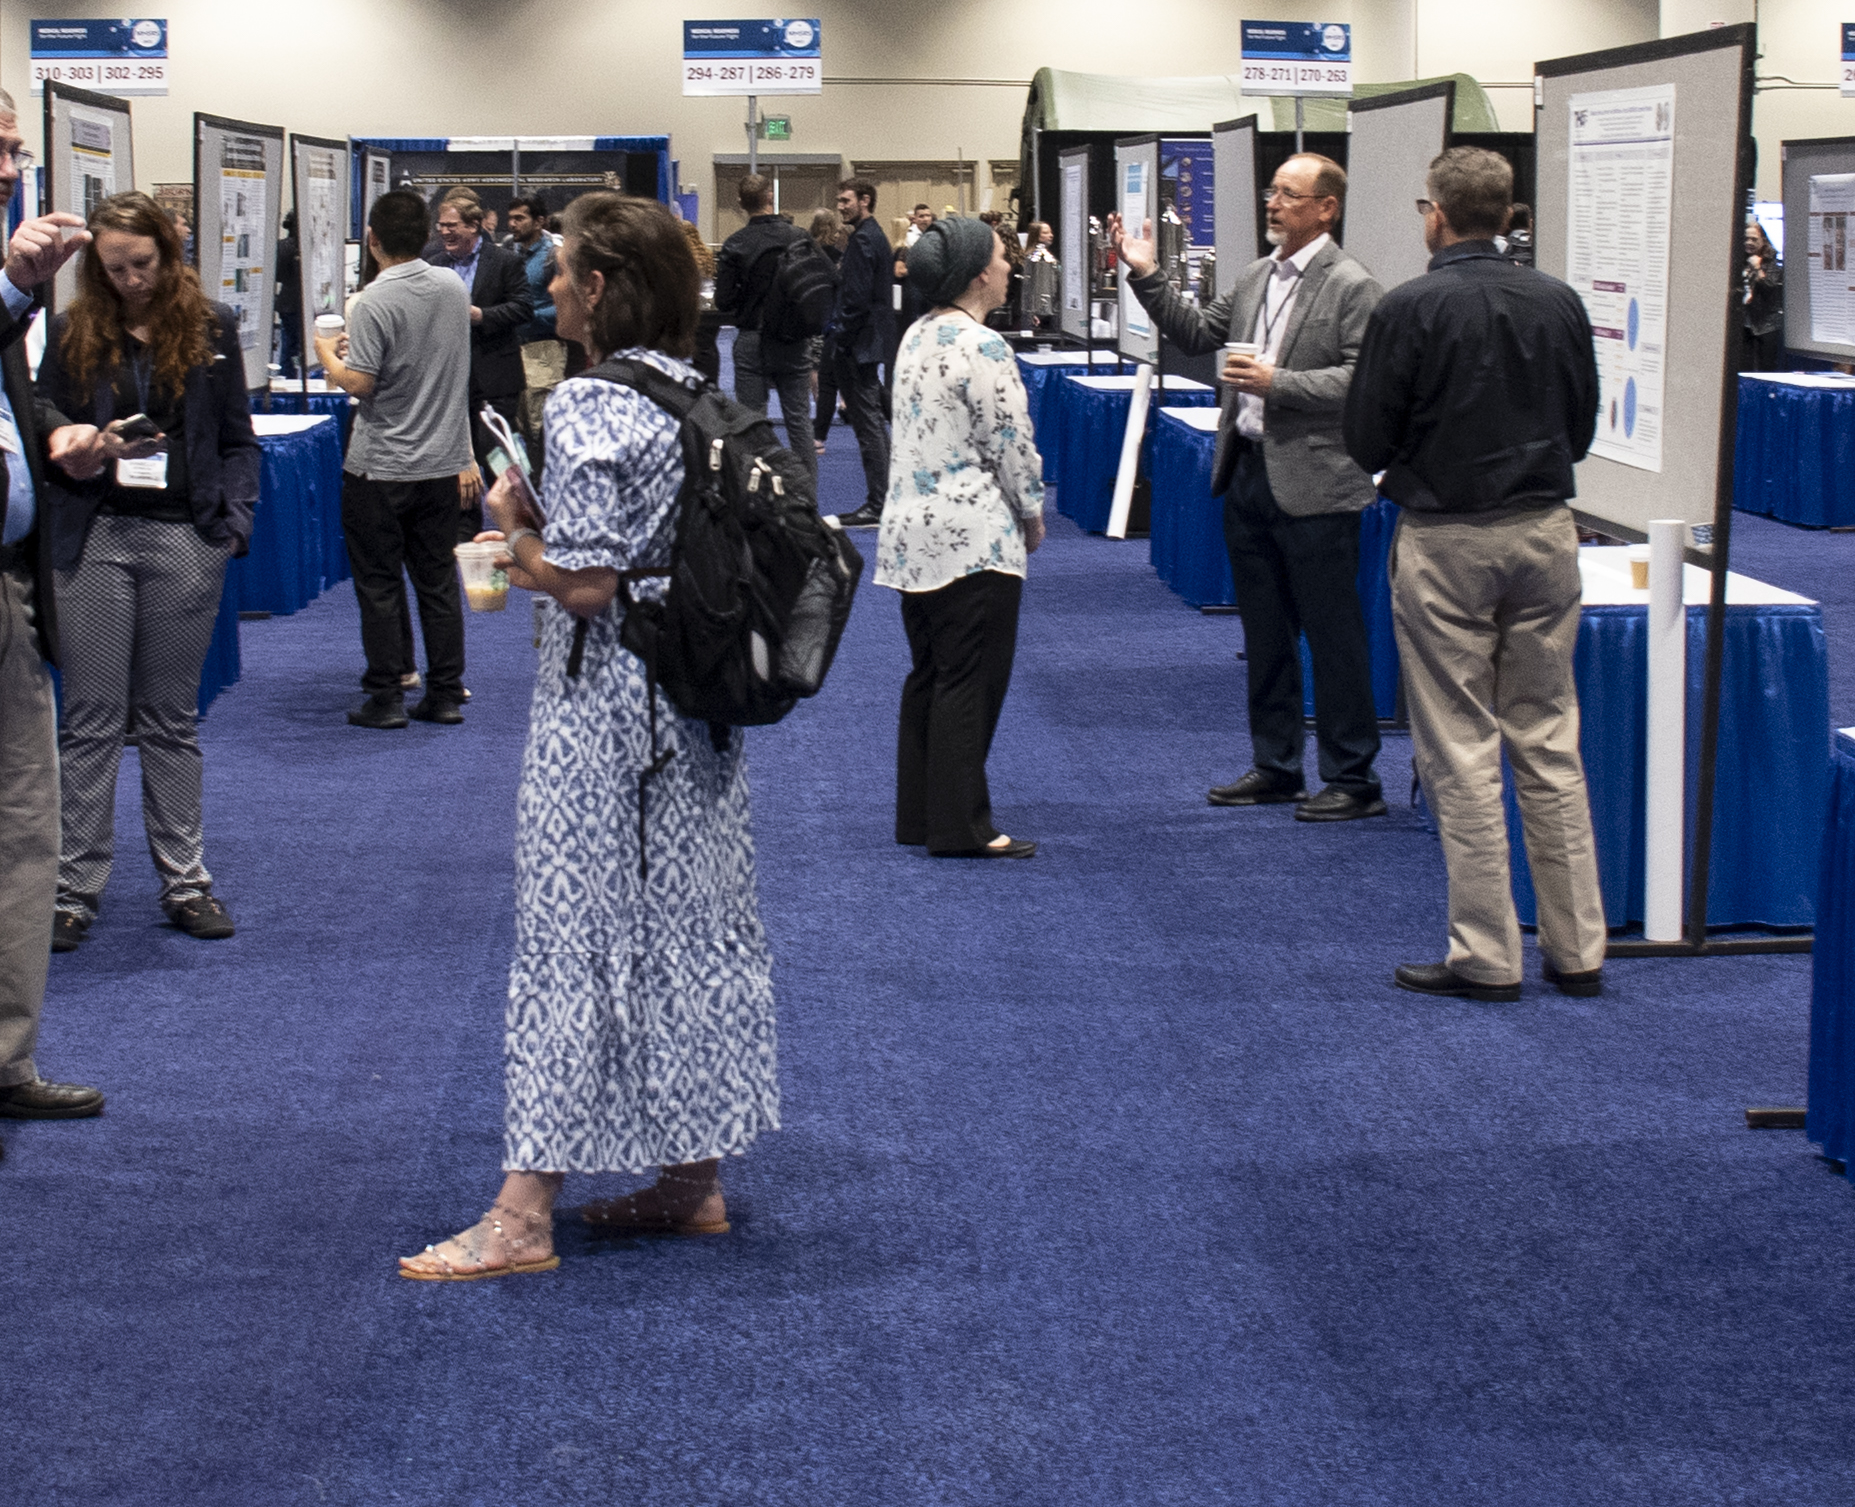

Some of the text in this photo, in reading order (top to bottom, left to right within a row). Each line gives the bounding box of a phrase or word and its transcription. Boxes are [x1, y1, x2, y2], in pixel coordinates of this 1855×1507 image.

[35, 66, 94, 80] 310-303
[105, 66, 164, 80] 302-295
[687, 66, 745, 80] 294-287
[756, 66, 815, 80] 286-279
[1244, 67, 1291, 80] 278-271
[1301, 68, 1347, 82] 270-263
